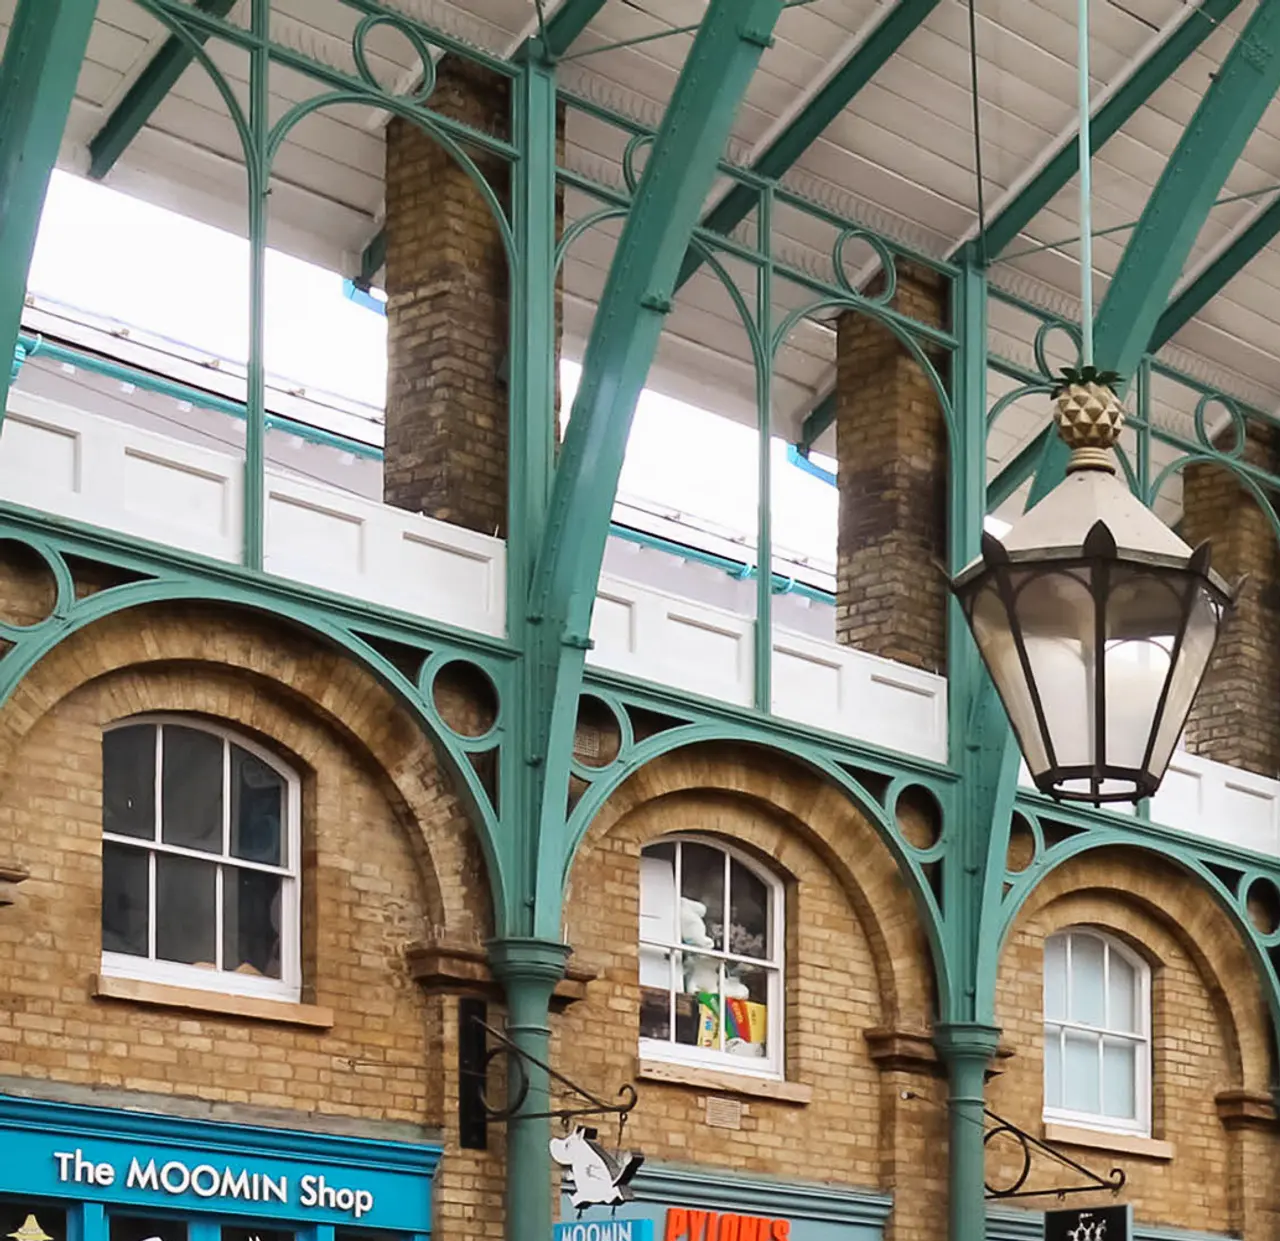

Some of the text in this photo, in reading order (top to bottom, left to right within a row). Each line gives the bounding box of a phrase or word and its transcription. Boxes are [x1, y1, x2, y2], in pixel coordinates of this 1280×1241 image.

[54, 1148, 375, 1219] The MOOMIN Shop
